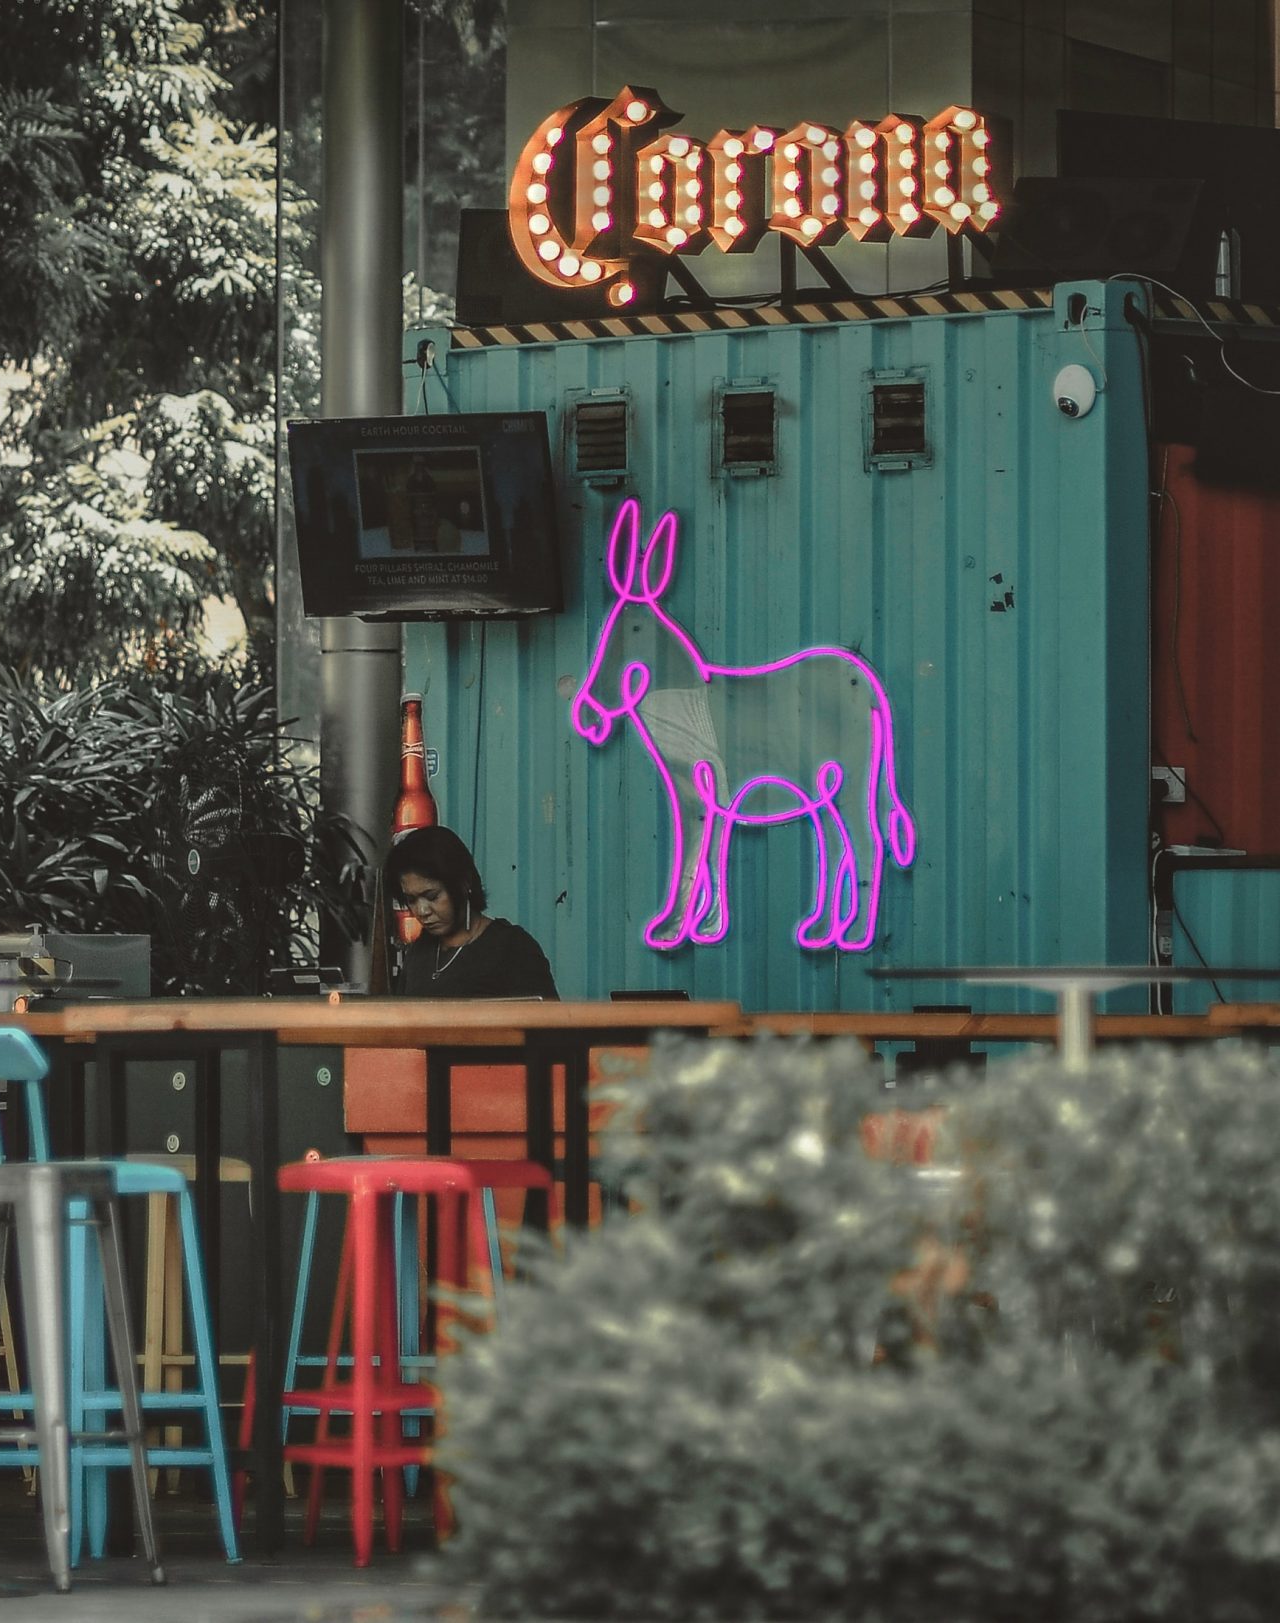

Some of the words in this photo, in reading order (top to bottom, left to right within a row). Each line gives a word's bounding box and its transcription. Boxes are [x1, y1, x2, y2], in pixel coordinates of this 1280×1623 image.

[508, 84, 1001, 307] Corona
[361, 426, 391, 437] EARTH
[393, 425, 419, 436] HOUR
[422, 424, 467, 435] COCKTAIL
[387, 575, 406, 585] LIME
[408, 574, 427, 585] AND
[451, 574, 461, 584] AT
